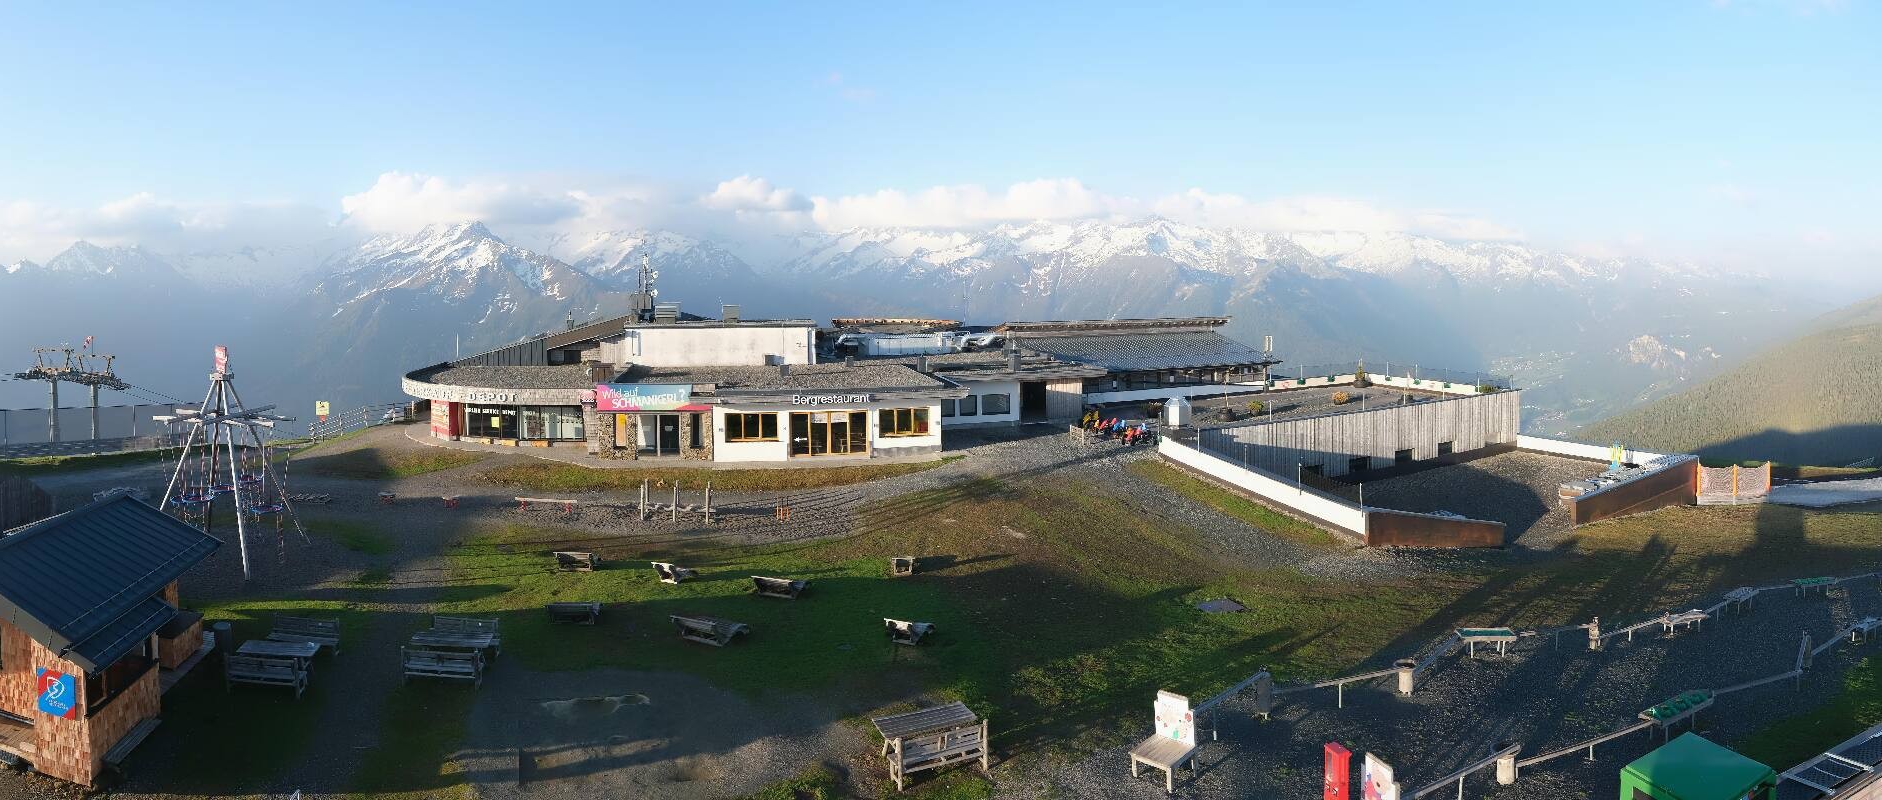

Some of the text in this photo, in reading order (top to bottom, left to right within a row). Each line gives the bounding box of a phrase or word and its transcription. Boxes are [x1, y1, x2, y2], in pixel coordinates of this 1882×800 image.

[468, 392, 518, 402] DEPOT
[601, 388, 623, 399] Wild
[623, 386, 639, 399] auf
[792, 393, 871, 406] Bergrestaurant
